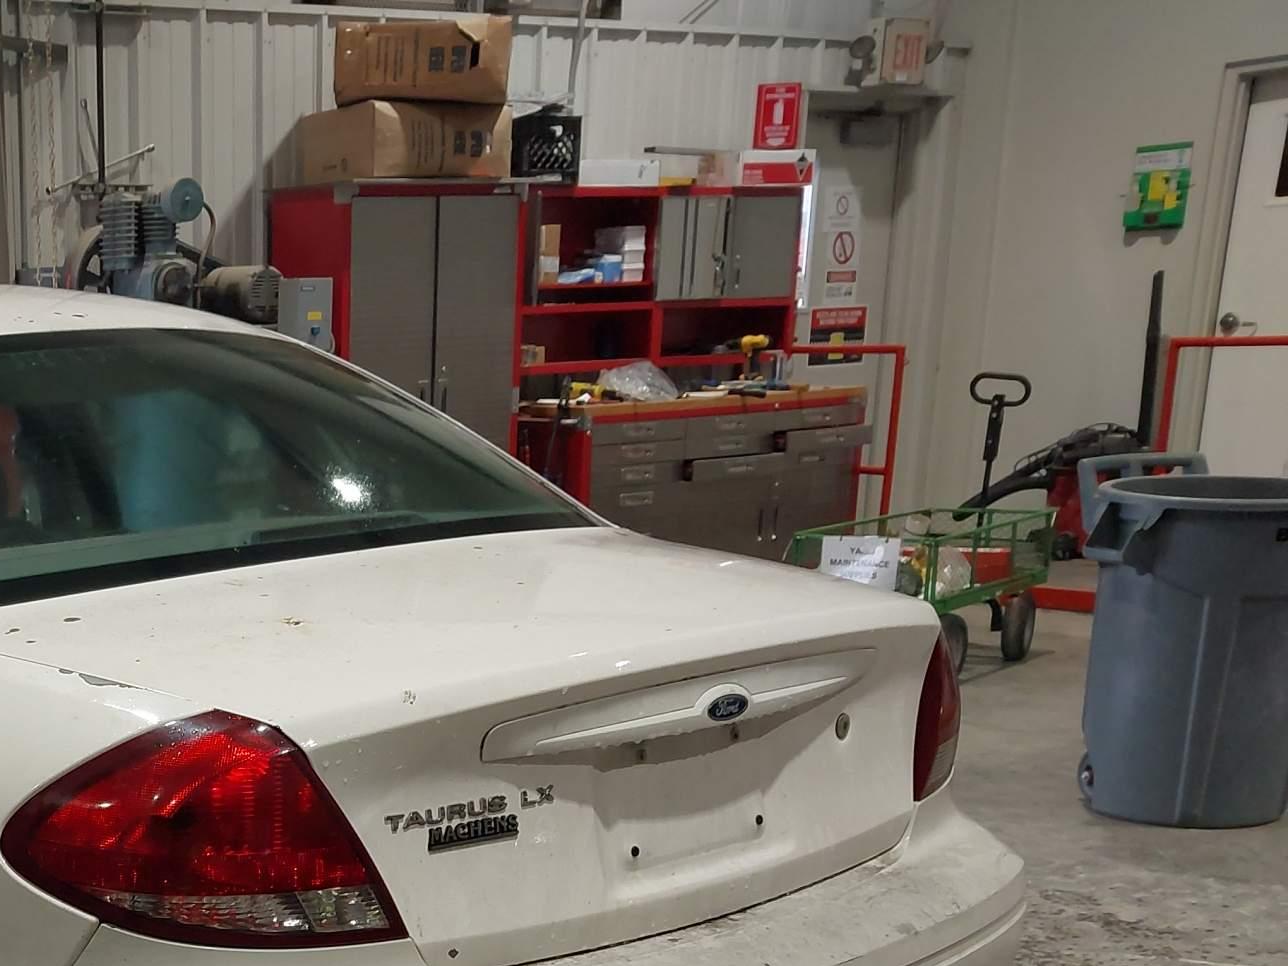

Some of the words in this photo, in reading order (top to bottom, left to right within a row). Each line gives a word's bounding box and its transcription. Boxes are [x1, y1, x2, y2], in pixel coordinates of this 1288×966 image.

[384, 795, 508, 834] TAURUS
[520, 784, 555, 809] LX
[429, 815, 519, 846] MACHENS
